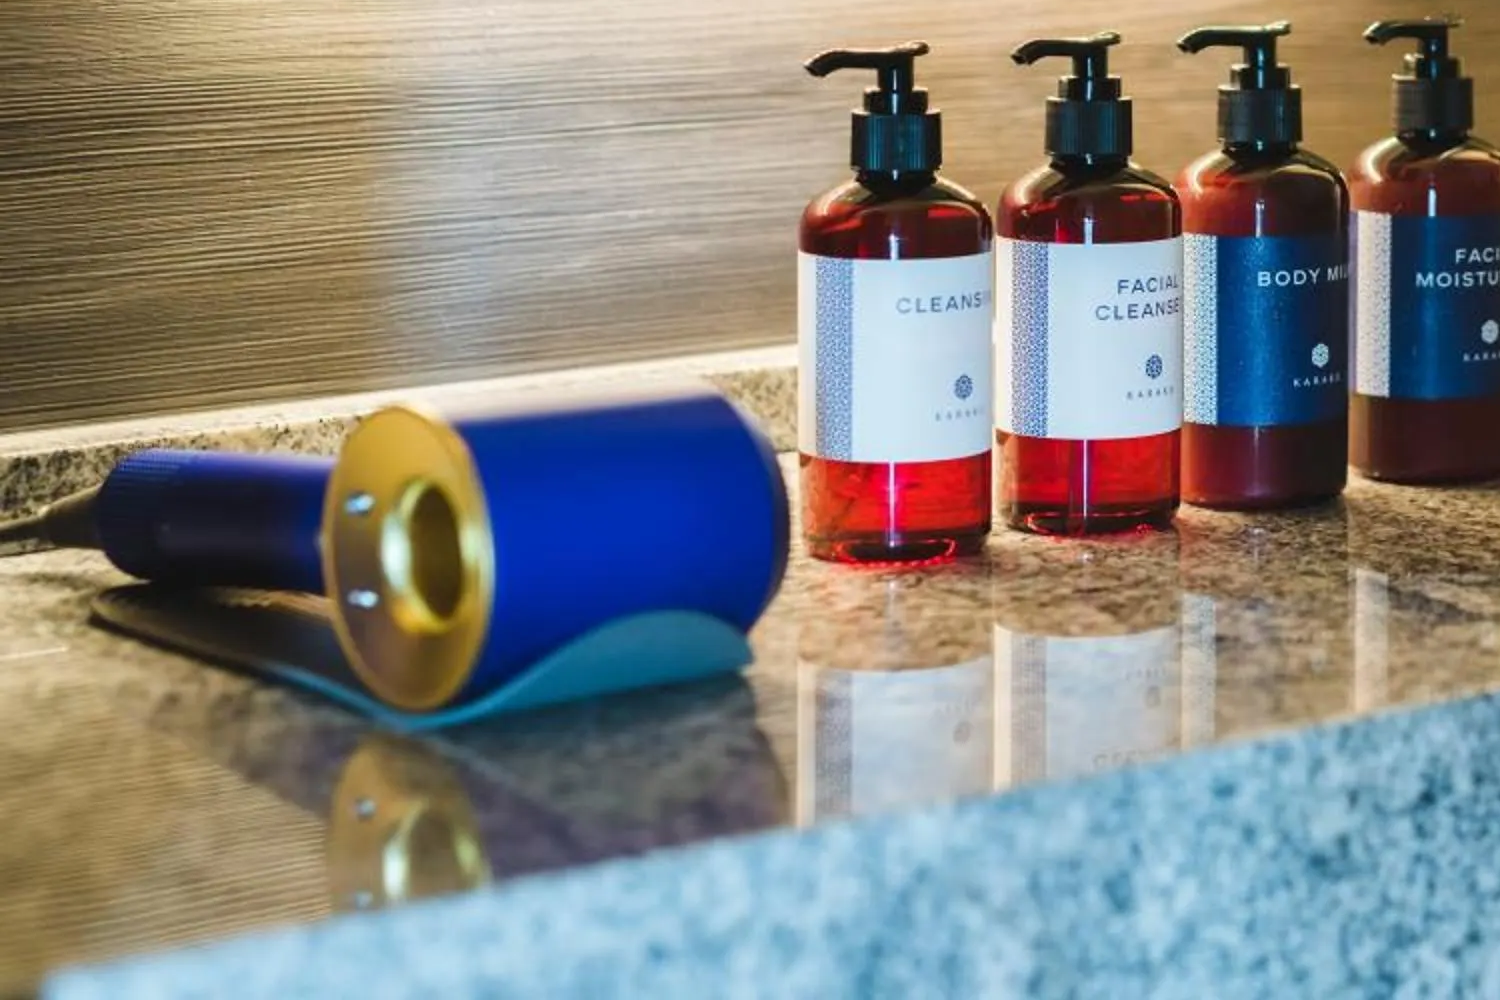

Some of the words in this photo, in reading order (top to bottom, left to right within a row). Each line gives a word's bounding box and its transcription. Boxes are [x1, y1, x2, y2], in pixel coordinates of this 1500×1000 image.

[1117, 275, 1179, 295] FACIAL
[1257, 267, 1321, 287] BODY
[1095, 297, 1180, 321] CLEANSE
